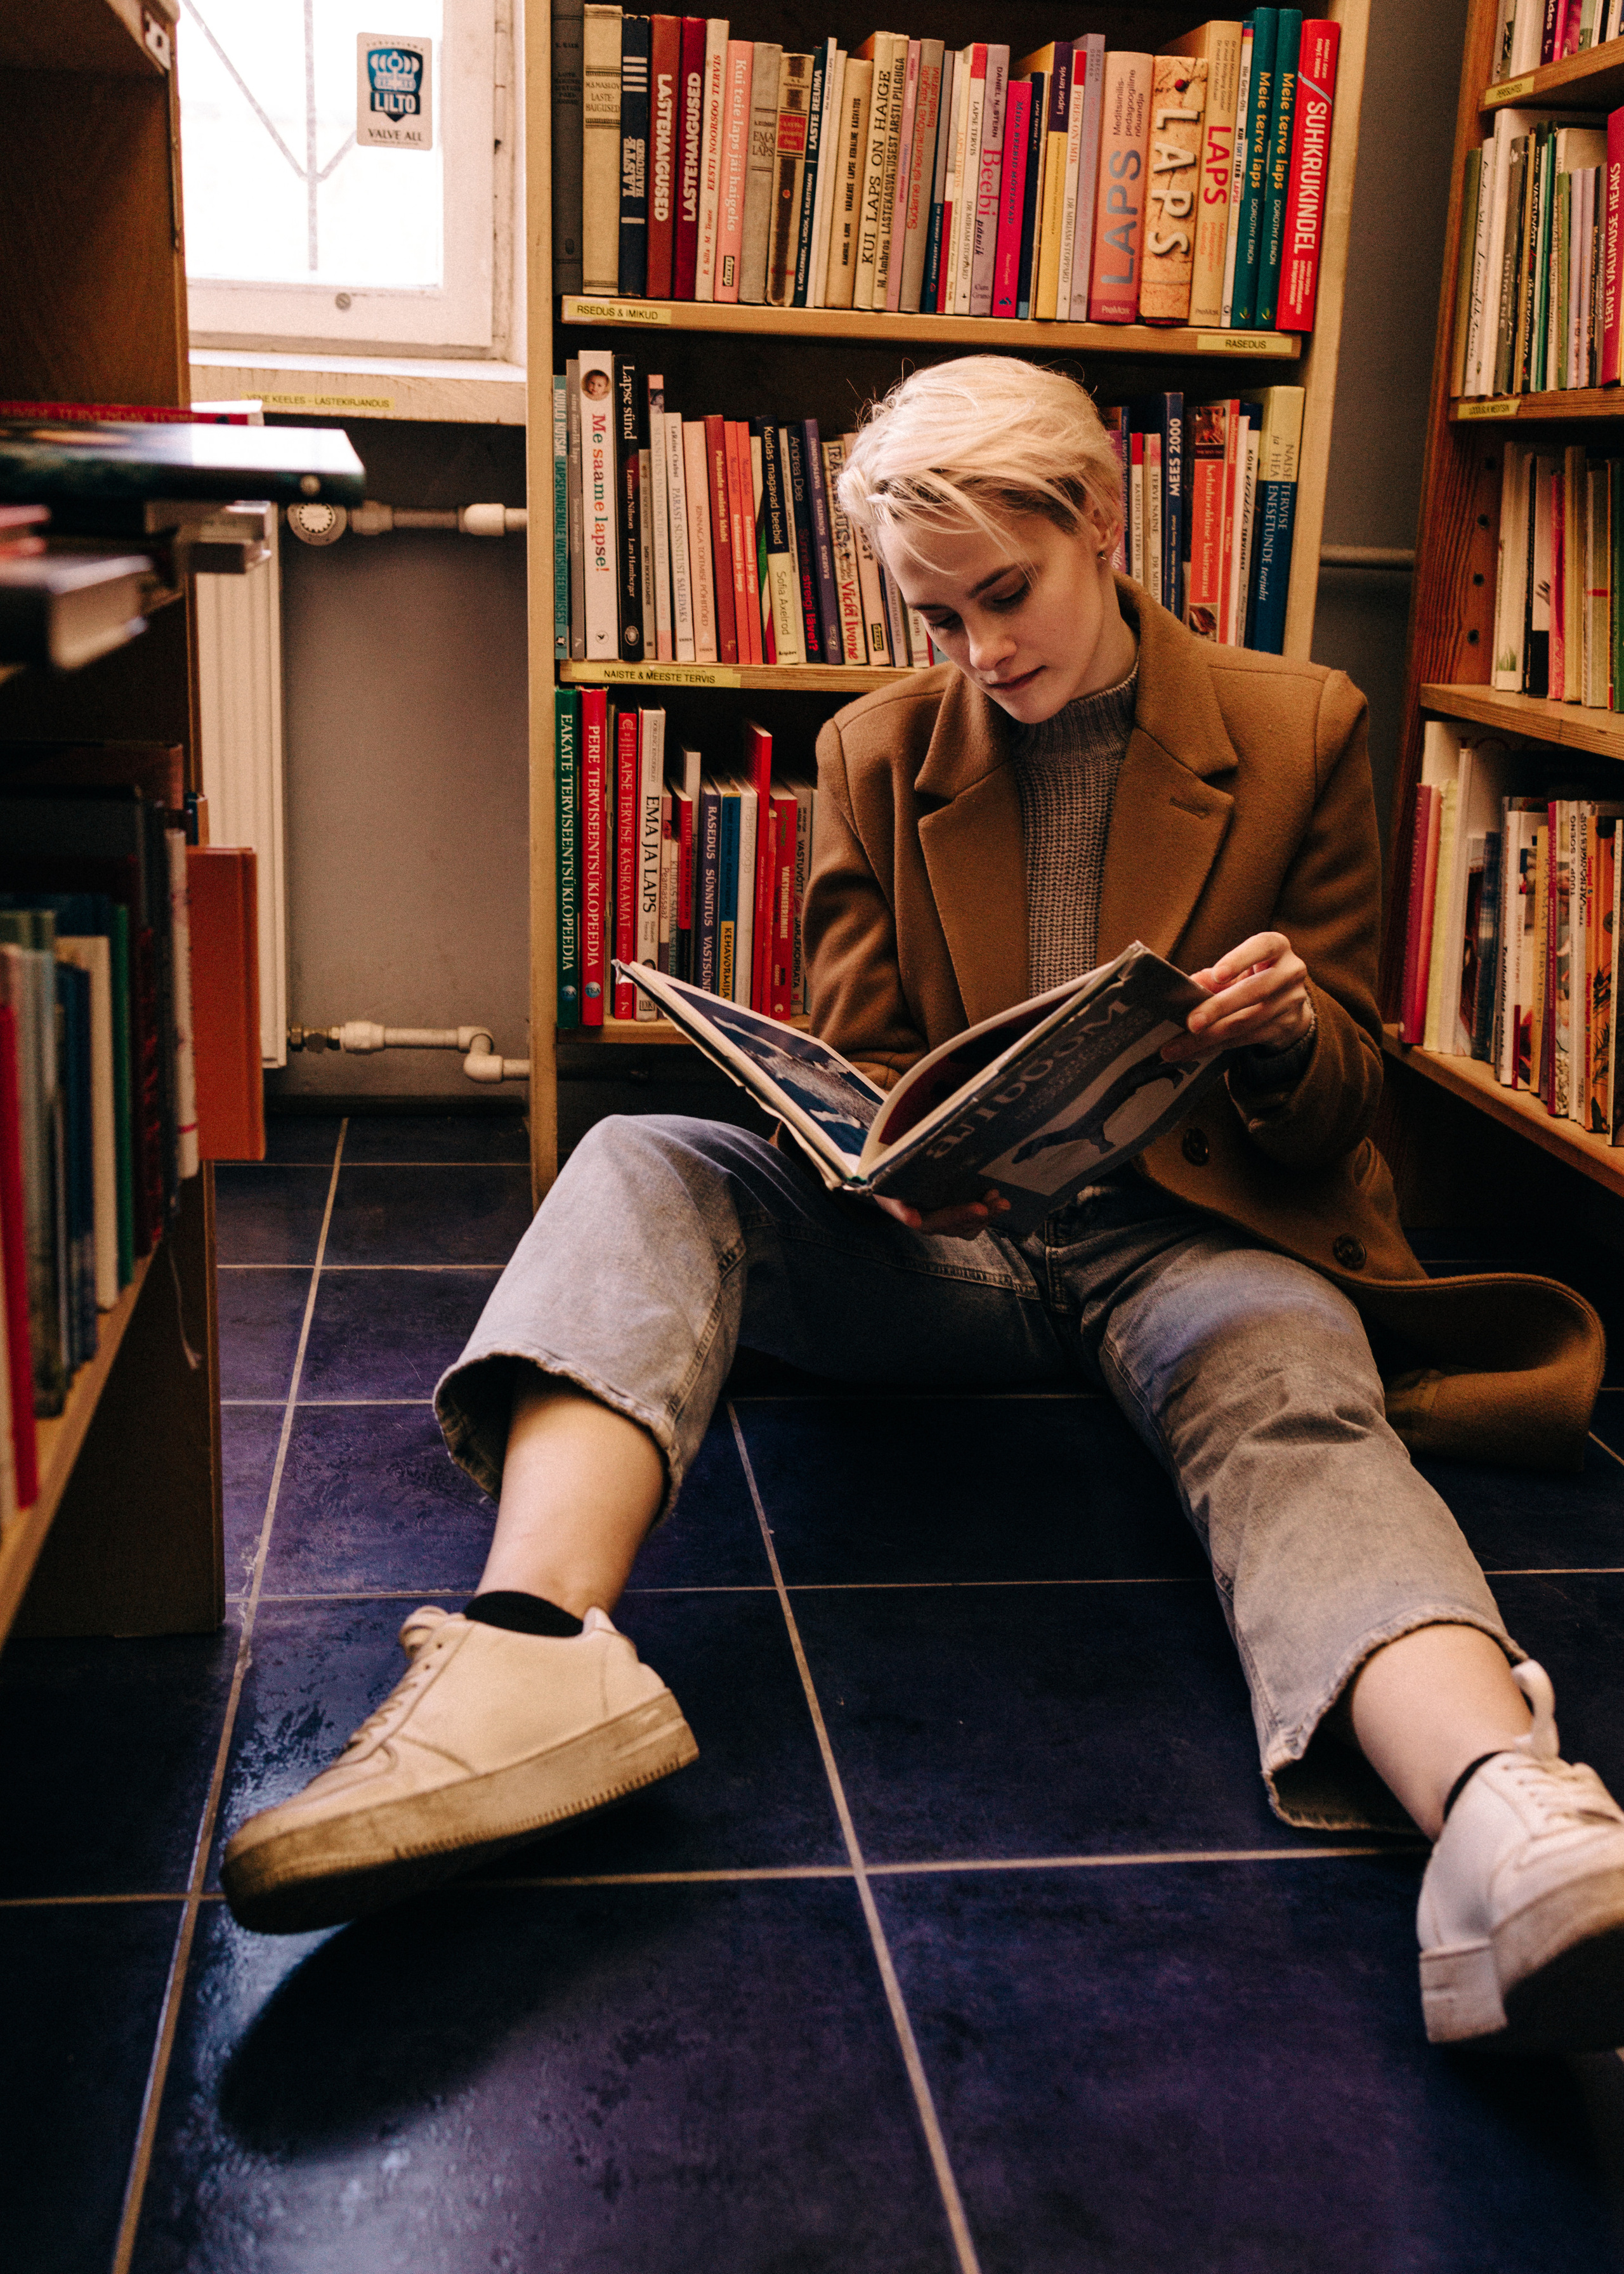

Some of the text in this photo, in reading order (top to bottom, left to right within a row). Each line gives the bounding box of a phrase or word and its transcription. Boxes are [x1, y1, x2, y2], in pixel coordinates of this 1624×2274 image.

[374, 92, 416, 114] LILTO
[809, 69, 823, 151] LASTE REUMA
[850, 98, 861, 129] KASVATUS
[891, 57, 905, 100] PILGUGA
[926, 67, 940, 128] taastusravi
[994, 65, 1004, 98] DANIEL
[1056, 65, 1067, 115] Lapse tervis
[1113, 77, 1125, 136] Meditsiinilis-
[1124, 69, 1136, 137] pedagoogiline
[1134, 93, 1145, 137] nõuandja
[368, 128, 422, 141] VALVE ALL
[654, 74, 672, 221] LASTEHAIGUSED
[682, 72, 701, 222] LASTEHAIGUSED
[706, 54, 721, 191] EESTI NOORSOO TERVIS
[725, 58, 747, 232] Kui teie laps jäi haigeks
[889, 103, 902, 134] ARSTI
[907, 183, 922, 230] Südame
[916, 65, 932, 107] haigete
[969, 101, 980, 157] LAPSE TERVIS
[991, 110, 1000, 138] STERN
[1011, 132, 1021, 168] BEEBID
[1070, 91, 1082, 165] PERES ON IMIK
[847, 161, 857, 180] LAPSE
[861, 70, 891, 265] KUI LAPS ON HAIGE
[978, 148, 1002, 217] Beebi
[1148, 108, 1200, 256] LAPS
[1203, 125, 1233, 205] LAPS
[1234, 159, 1243, 178] TEEB
[1245, 71, 1271, 265] Meie terve laps DOROTHY EINON
[1268, 72, 1295, 265] Meie terve laps DOROTHY EINON
[1293, 101, 1328, 254] SUHKRUKINDEL
[962, 200, 973, 280] DR MIRIAM STOPPARD
[1061, 197, 1075, 283] DR MIRIAM STOPPARD
[1101, 149, 1141, 285] LAPS
[1604, 162, 1621, 332] TERVE VÄLIMUSE HEAKS
[576, 305, 658, 320] RSEDUS & IMIKUD
[1224, 339, 1267, 350] RASEDUS
[272, 395, 306, 404] KEELES
[315, 397, 390, 408] LASTEKIRJANDUS
[554, 389, 566, 420] KUULO
[619, 365, 637, 440] Lapse sünd
[554, 421, 566, 457] KUTSAR
[790, 435, 804, 503] Andrea Dee
[1169, 417, 1182, 497] MEES 2000
[554, 461, 567, 541] LAPSEVANEMALE
[591, 414, 610, 572] Me saame lapse!
[672, 487, 683, 521] PÄRAST
[715, 450, 729, 542] Paksude naiste klubi
[763, 426, 783, 544] Kuidas magavad beebid
[1258, 435, 1281, 601] ja HEA ENESETUNDE teejuht
[1277, 444, 1295, 530] NAISE TERVISE
[626, 469, 637, 598] Lennart Nilsson Lars Hamberger
[674, 523, 686, 575] SÜNNITUST
[695, 505, 710, 627] RINNAGA TOITMISE PÕHITÕED
[1151, 556, 1159, 568] DR
[677, 577, 688, 623] SALEDAKS
[776, 570, 791, 635] Sofia Axelrod
[797, 527, 819, 652] Sünnitusstreigi lävel?
[603, 670, 716, 683] NAISTE & MEESTE TERVIS
[560, 713, 575, 971] EAKATE TERVISEENTSÜKLOPEEDIA
[587, 725, 603, 967] PERE TERVISEENTSÜKLOPEEDIA
[619, 753, 633, 928] LAPSE TERVISE KÄSIRAAMAT
[642, 796, 660, 914] EMA JA LAPS
[704, 805, 718, 928] RASEDUS SÜNNITUS
[795, 839, 806, 894] VASTUVÕTT
[779, 865, 790, 939] VAKTSINEERIMINE
[722, 926, 733, 999] KEHAVORMIJA
